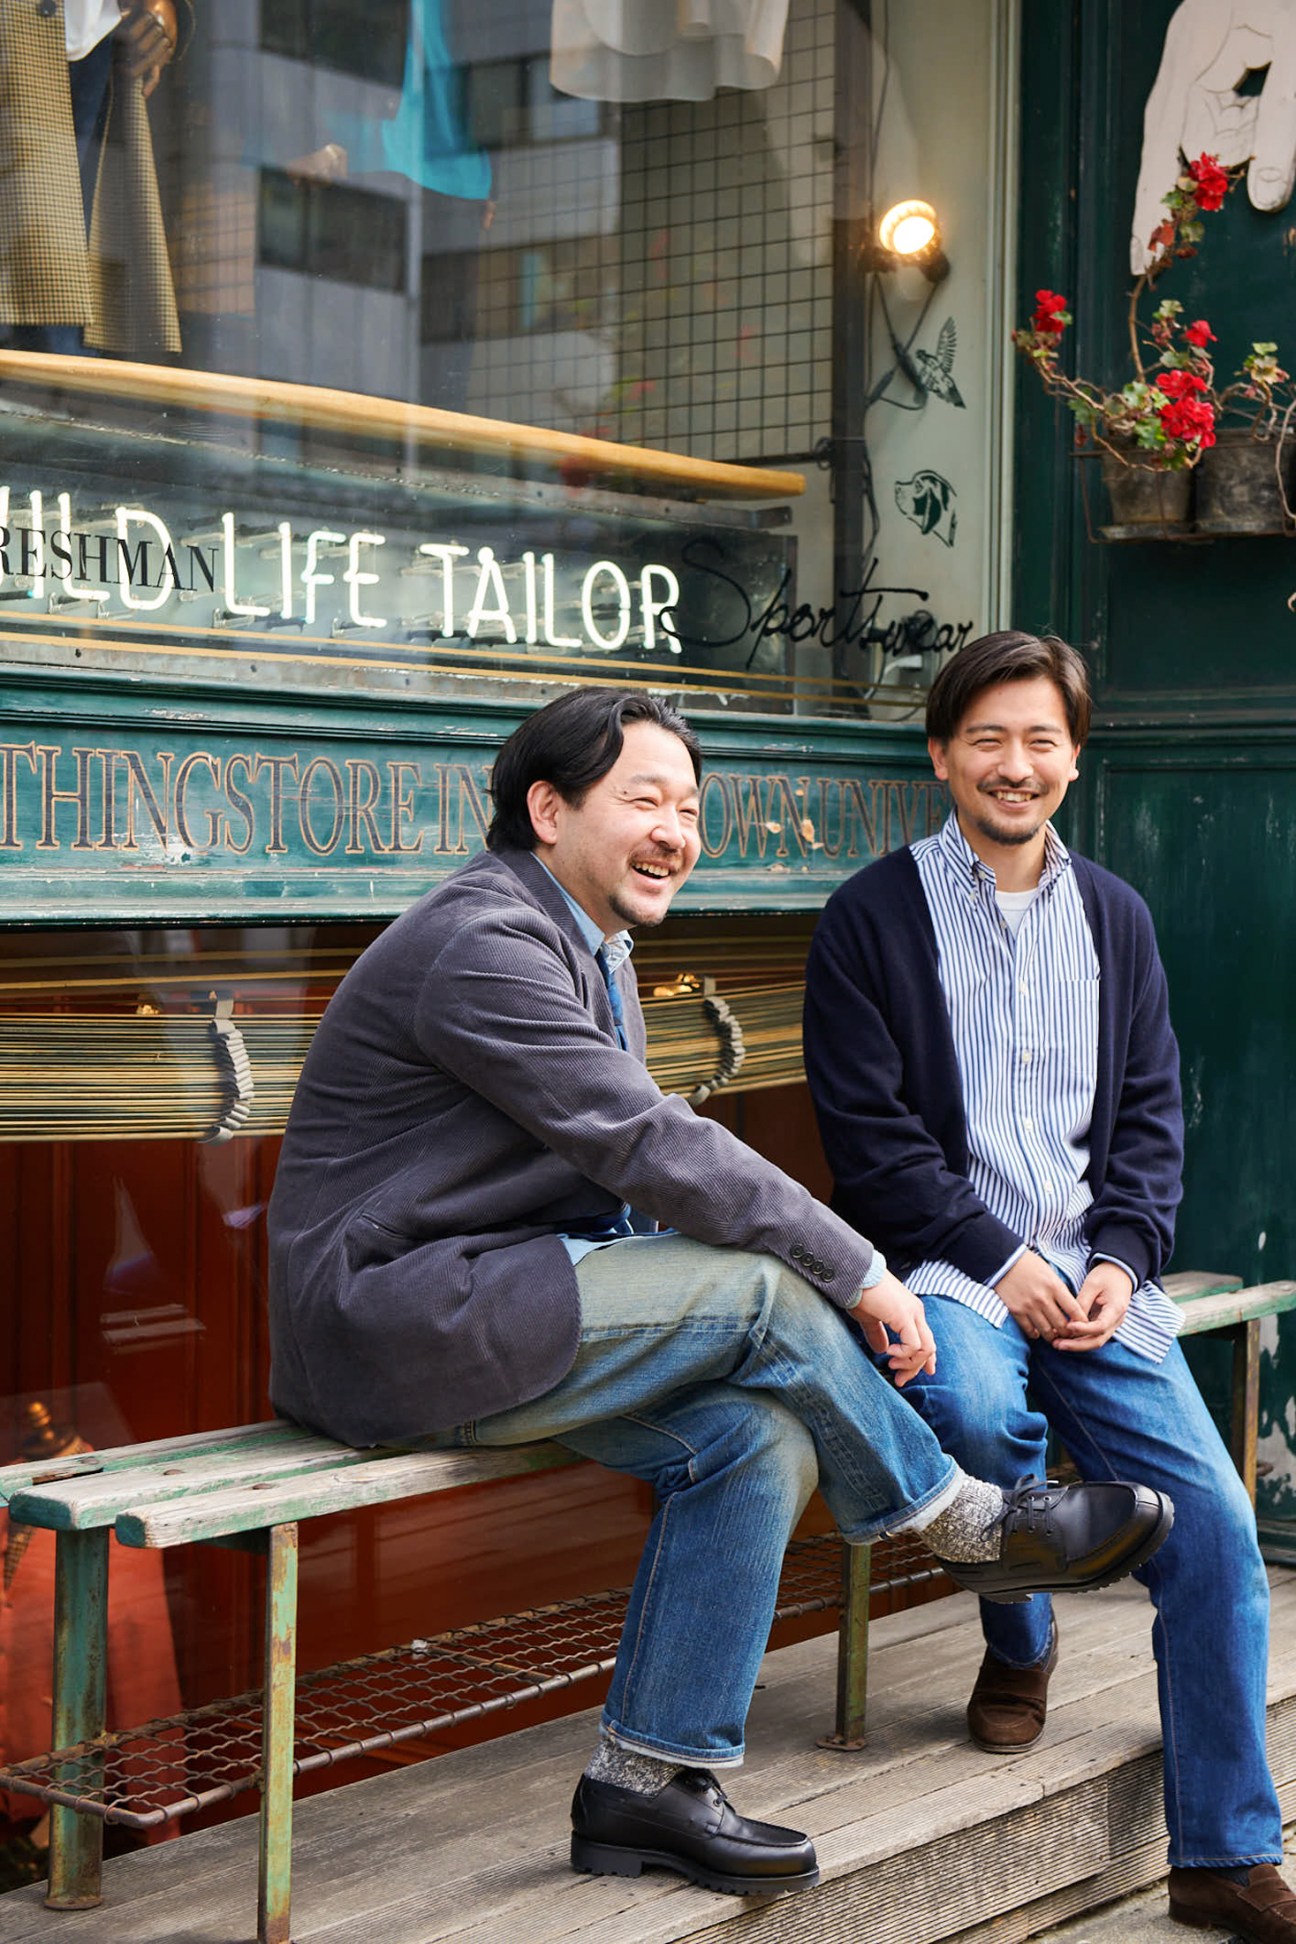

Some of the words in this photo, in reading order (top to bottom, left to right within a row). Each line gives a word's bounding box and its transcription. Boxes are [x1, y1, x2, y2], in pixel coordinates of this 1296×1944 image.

[0, 485, 174, 611] ILD
[222, 511, 388, 628] LIFE
[419, 544, 683, 654] TAILOR
